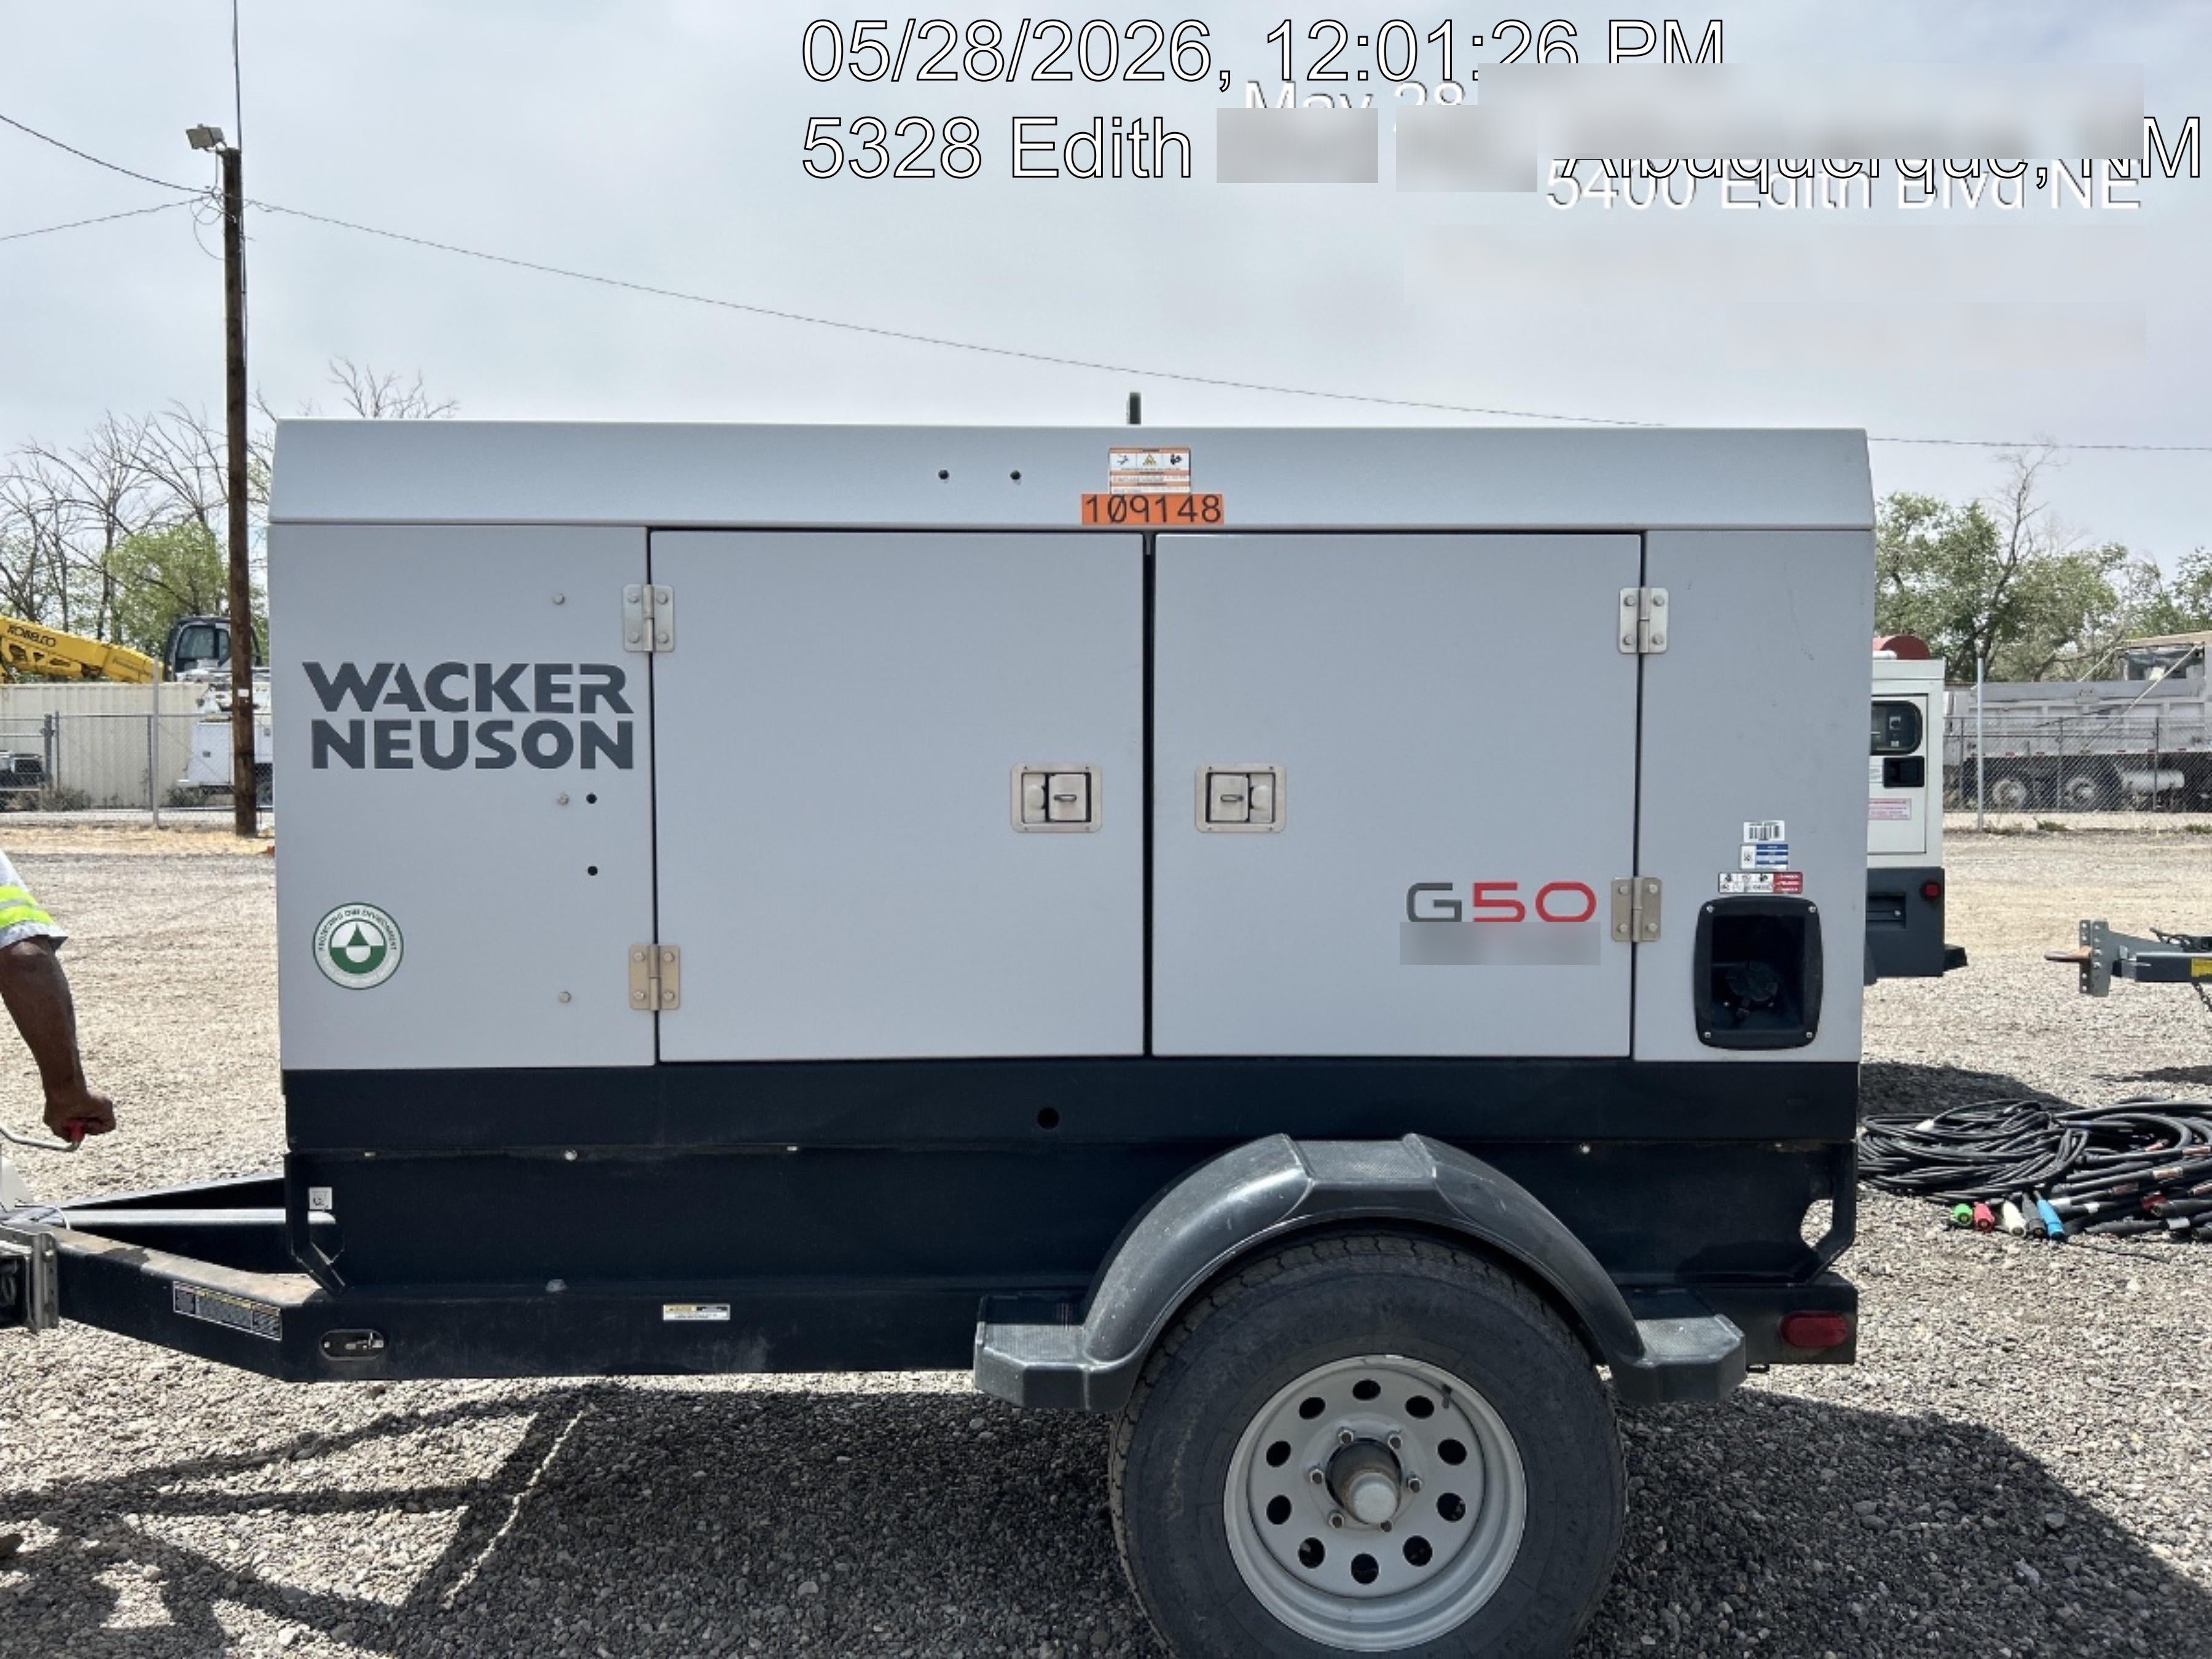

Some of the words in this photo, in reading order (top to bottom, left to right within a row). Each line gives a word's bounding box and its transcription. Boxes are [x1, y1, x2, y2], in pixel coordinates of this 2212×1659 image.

[1085, 494, 1221, 522] 109148
[302, 661, 634, 713] WACKER
[312, 719, 633, 770] NEUSON
[1406, 882, 1597, 922] G50
